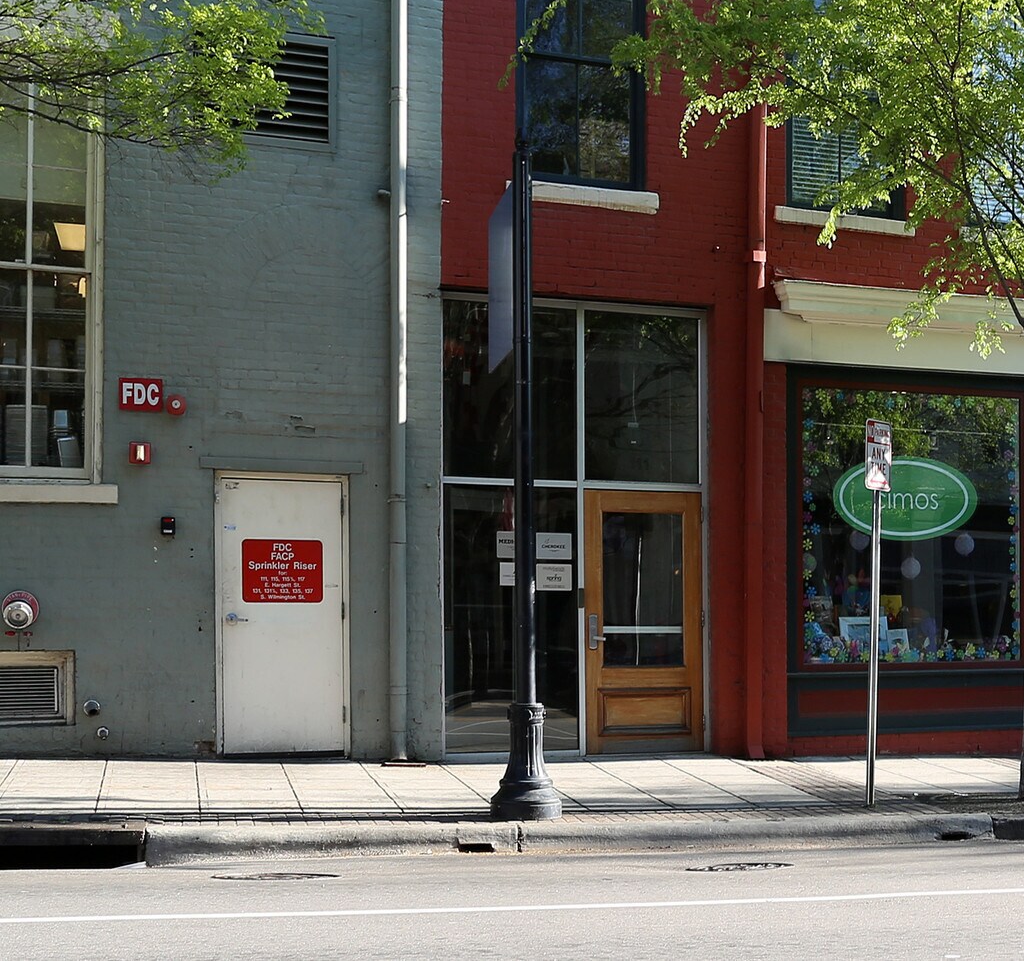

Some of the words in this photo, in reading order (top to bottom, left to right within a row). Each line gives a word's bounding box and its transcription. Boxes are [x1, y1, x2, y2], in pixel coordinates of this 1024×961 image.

[122, 382, 160, 406] FDC
[872, 447, 886, 460] ANY
[273, 543, 292, 552] FDC
[271, 552, 294, 560] FACP
[248, 561, 289, 571] Sprinkler
[294, 562, 317, 570] Riser
